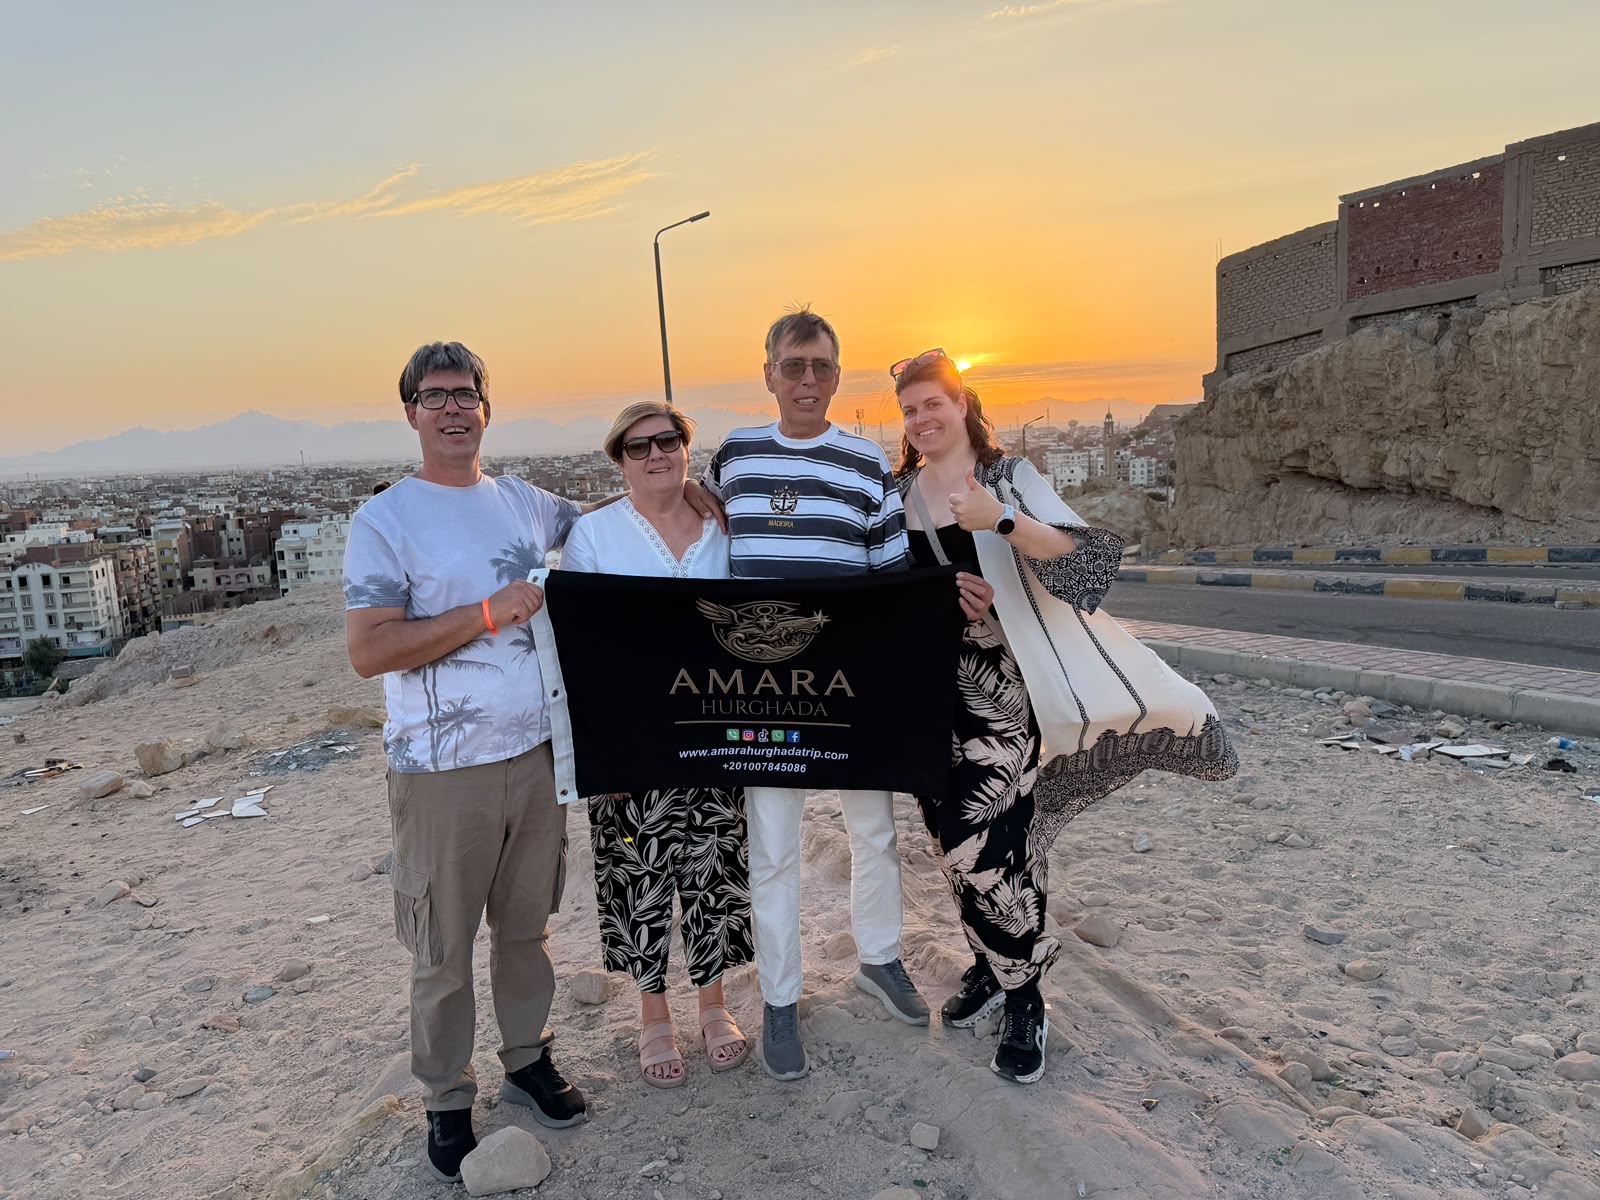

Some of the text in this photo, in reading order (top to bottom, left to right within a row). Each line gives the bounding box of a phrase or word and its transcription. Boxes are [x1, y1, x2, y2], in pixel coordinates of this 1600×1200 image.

[768, 519, 794, 528] MADEIRA
[669, 667, 855, 697] AMARA
[701, 700, 828, 716] HURGHADA
[679, 746, 849, 760] www.amarahurghadatrip.com
[722, 761, 807, 773] +201007845086
